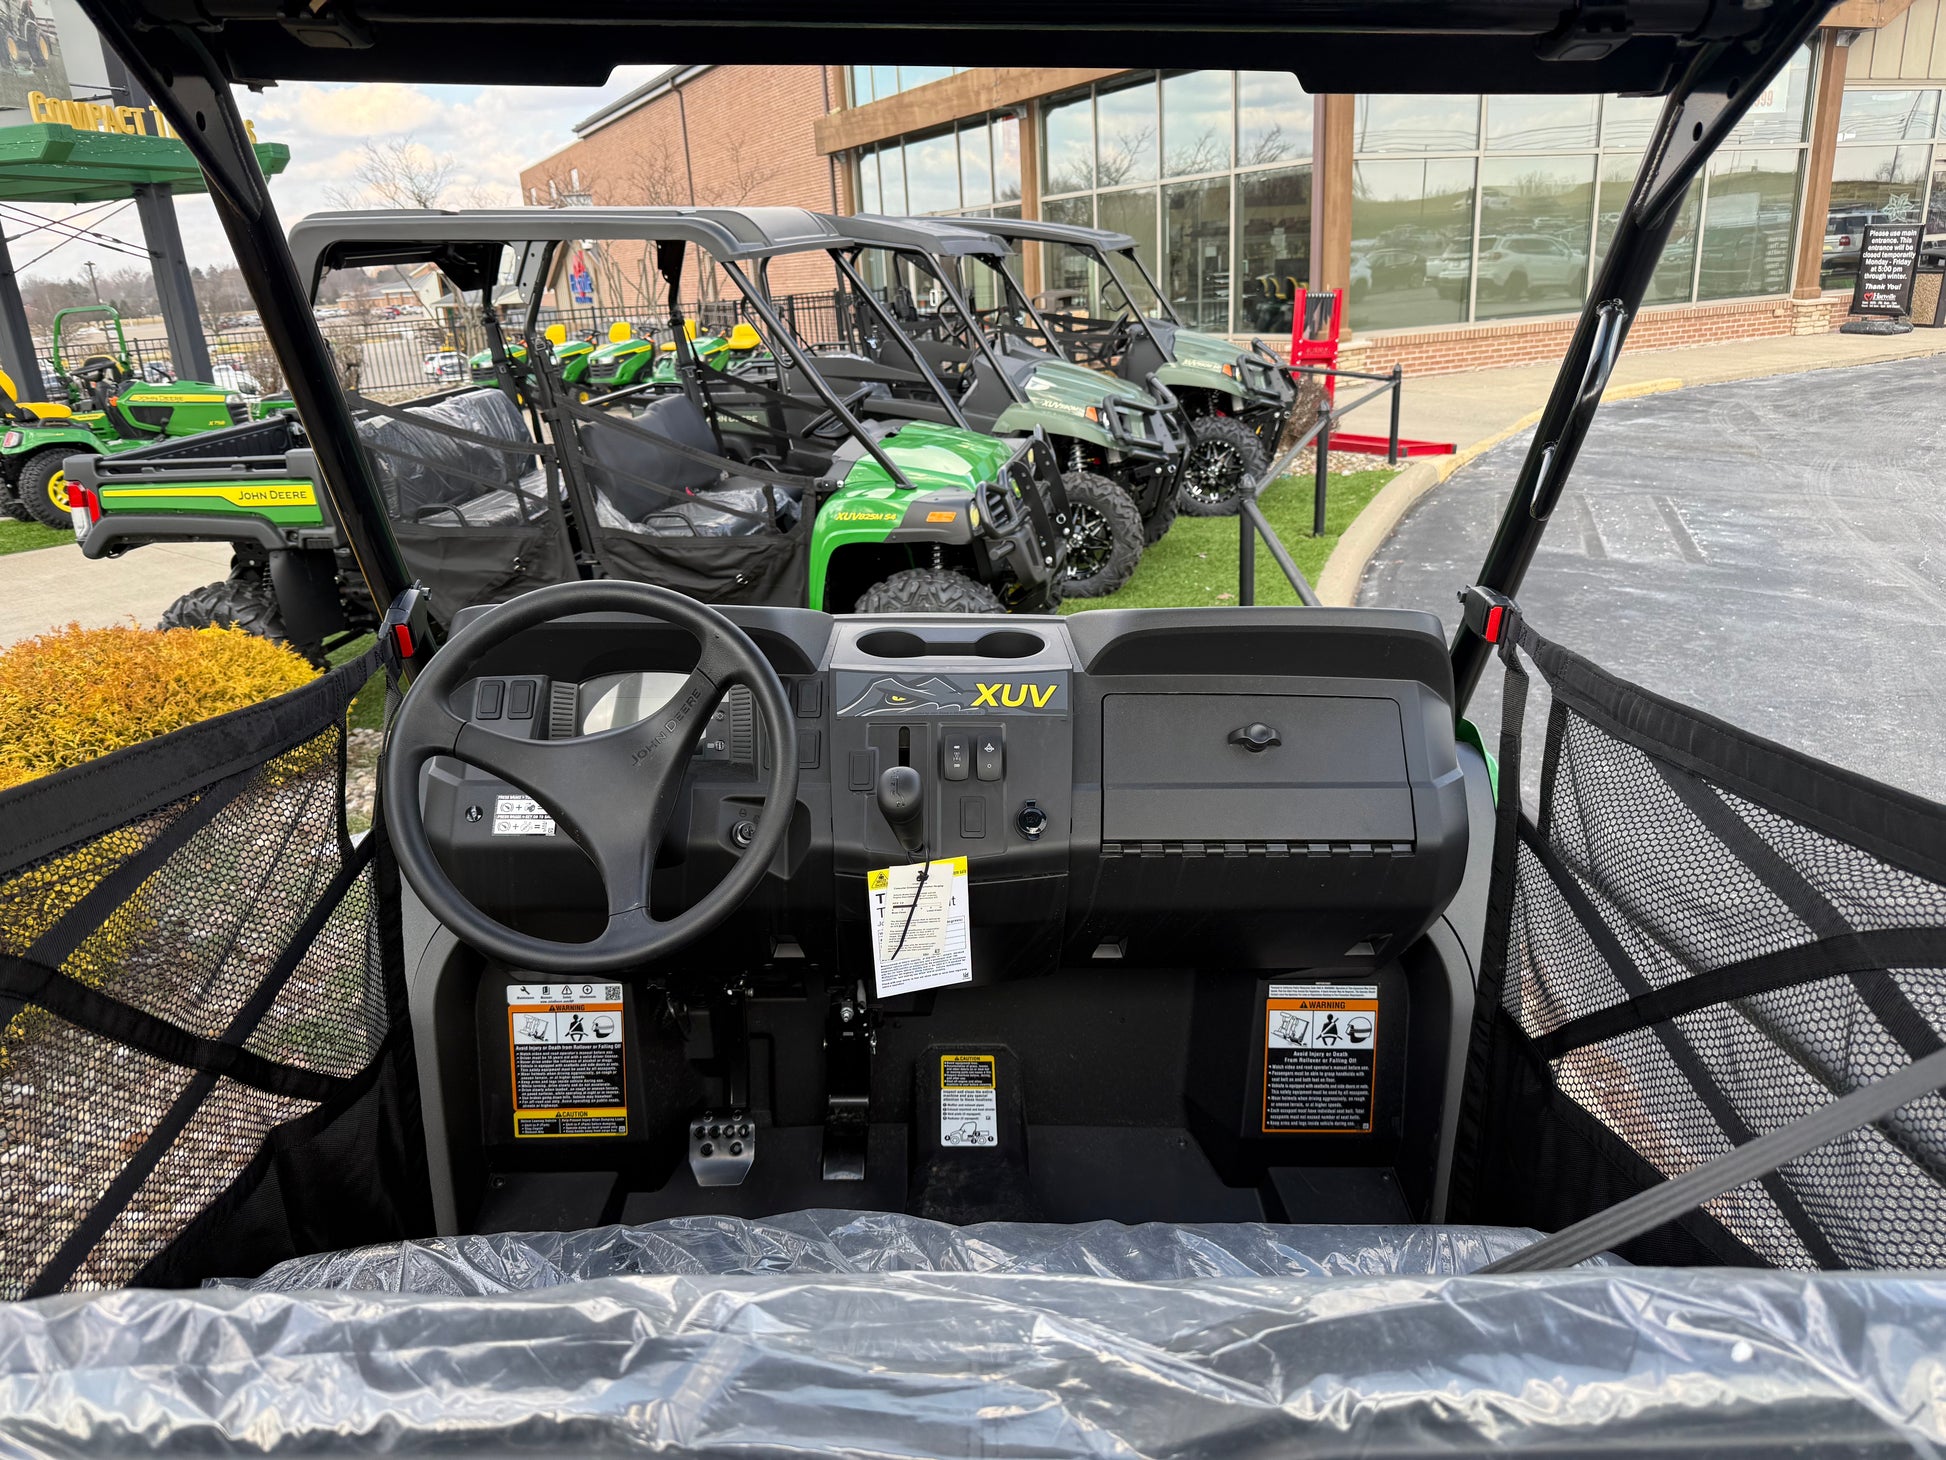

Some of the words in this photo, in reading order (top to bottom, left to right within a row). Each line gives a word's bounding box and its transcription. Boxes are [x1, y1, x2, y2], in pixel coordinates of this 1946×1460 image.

[27, 90, 145, 136] COMPACT
[238, 490, 268, 500] JOHN
[270, 490, 307, 500] DEERE
[970, 683, 1058, 708] XUV
[632, 732, 666, 767] JOHN
[665, 688, 702, 733] DEERE
